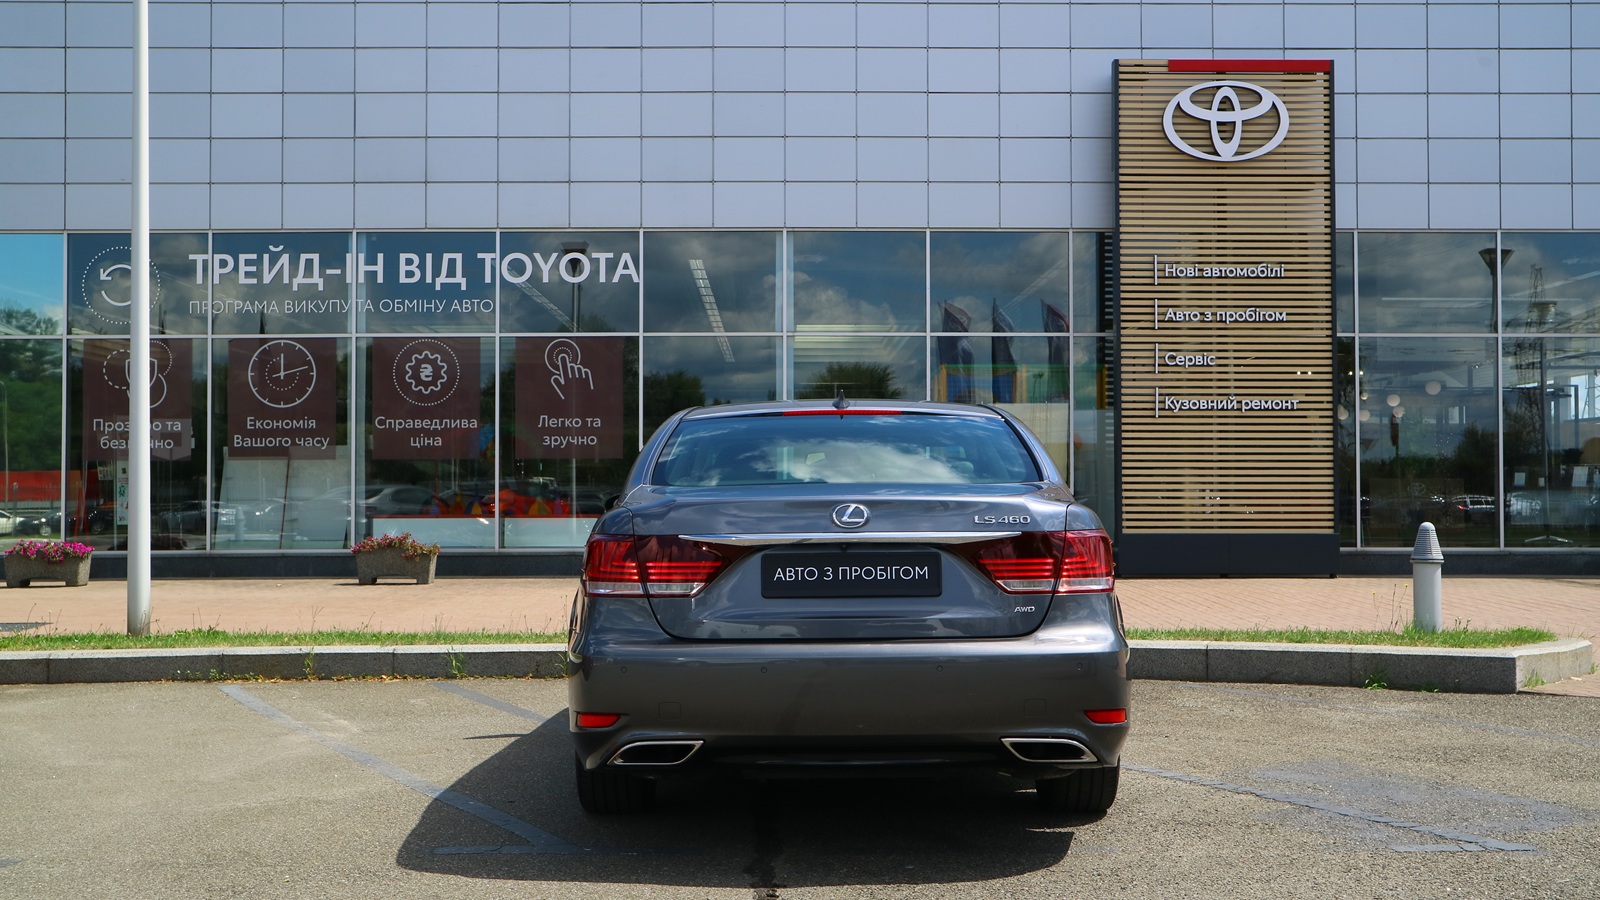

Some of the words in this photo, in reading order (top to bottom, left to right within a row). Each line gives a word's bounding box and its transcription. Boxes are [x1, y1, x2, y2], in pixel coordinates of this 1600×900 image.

[189, 245, 384, 291] ТРЕЙД-ІН
[399, 252, 467, 291] ВІД
[477, 252, 640, 284] TOYOTA
[1165, 264, 1199, 277] Нові
[1203, 263, 1285, 278] автомобілі
[189, 300, 279, 314] ПРОГРАМА
[285, 299, 352, 314] ВИКУПУ
[355, 299, 375, 313] ТА
[379, 298, 446, 314] ОБМІНУ
[450, 299, 494, 313] АВТО
[1165, 308, 1201, 322] Авто
[1204, 311, 1212, 322] з
[1216, 308, 1287, 325] пробігом
[1165, 352, 1216, 368] Сервіс
[1165, 396, 1237, 413] Кузовний
[1242, 400, 1299, 412] ремонт
[93, 418, 162, 434] Прозо
[165, 421, 182, 431] та
[246, 416, 316, 429] Економія
[375, 416, 478, 431] Справедлива
[538, 415, 582, 428] Легко
[586, 418, 601, 428] та
[100, 435, 174, 449] безно
[233, 434, 291, 447] Вашого
[295, 437, 330, 450] часу
[410, 434, 442, 448] ціна
[542, 435, 597, 448] зручно
[974, 515, 996, 524] LS
[997, 515, 1031, 524] 460
[773, 567, 819, 581] АВТО
[823, 566, 834, 581] З
[838, 566, 929, 580] ПРОБІГОМ
